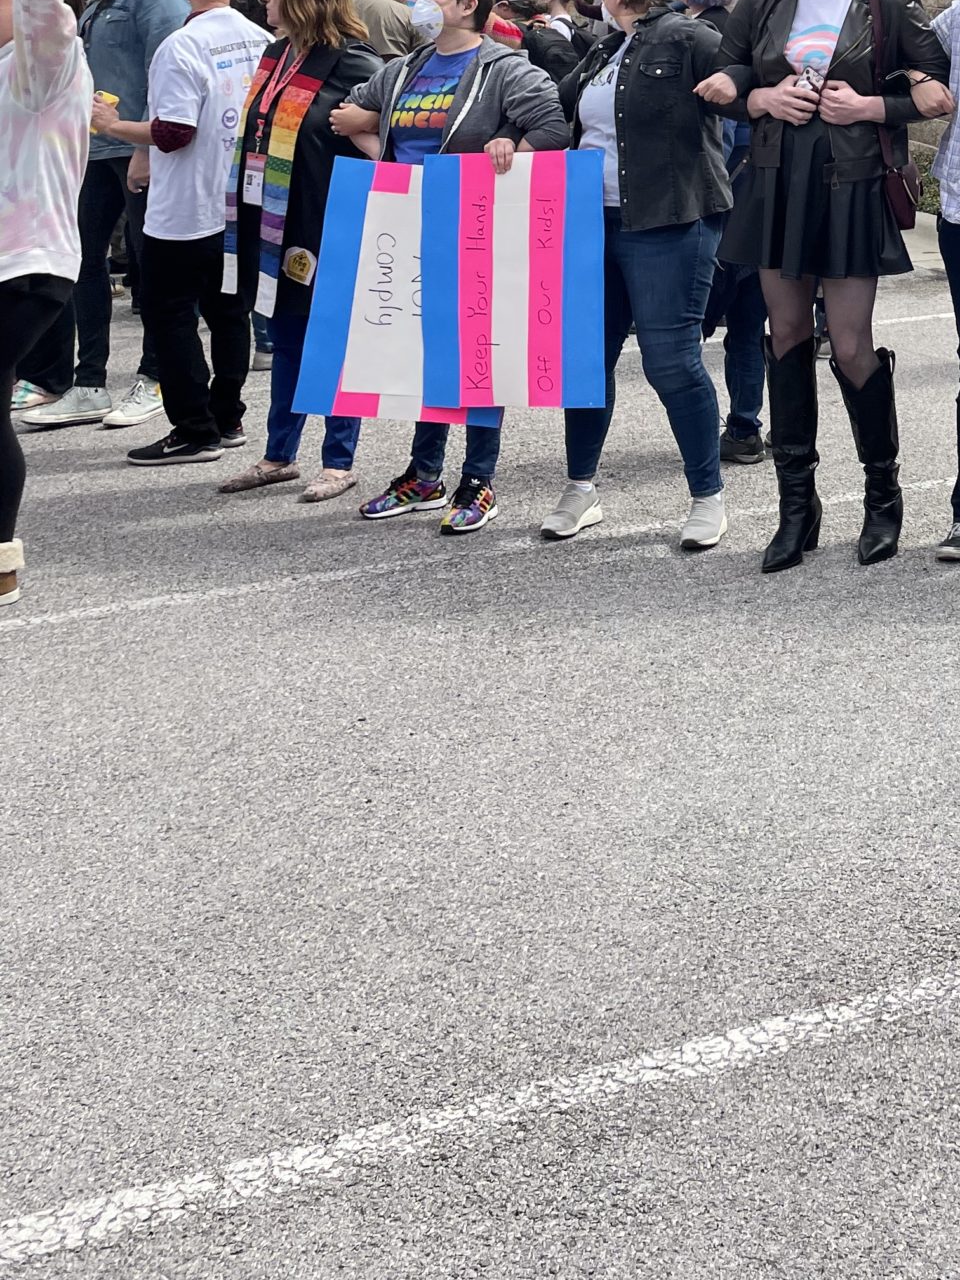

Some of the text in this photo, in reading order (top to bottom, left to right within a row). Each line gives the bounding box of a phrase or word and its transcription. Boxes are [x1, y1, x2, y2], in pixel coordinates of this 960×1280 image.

[465, 195, 501, 389] Keep Your Hands
[535, 198, 557, 392] Off Our Kids!
